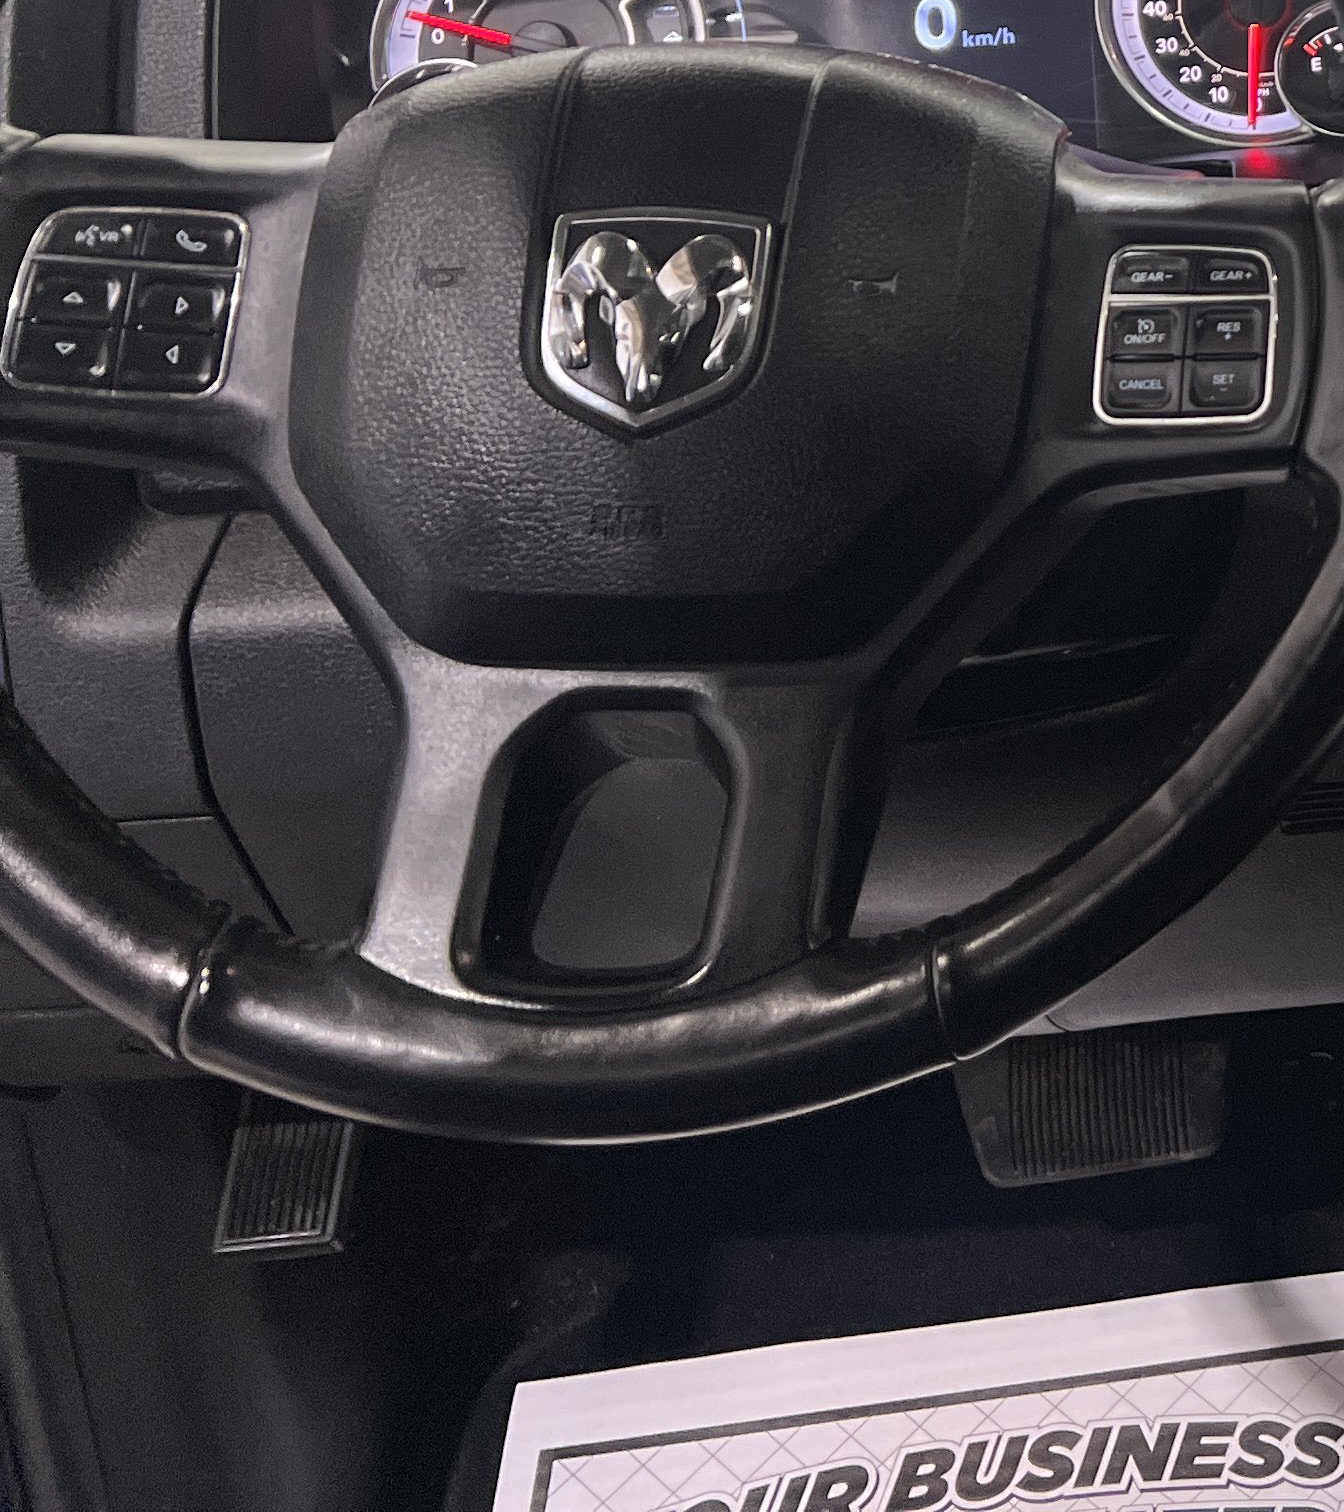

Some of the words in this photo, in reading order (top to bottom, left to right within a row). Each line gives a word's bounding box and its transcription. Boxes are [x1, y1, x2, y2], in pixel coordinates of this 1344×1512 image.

[1143, 0, 1167, 17] 40
[431, 27, 445, 45] 0
[961, 27, 1016, 48] km/h
[1155, 37, 1179, 54] 30
[1310, 57, 1322, 72] E
[1179, 65, 1201, 83] 20
[1208, 85, 1230, 103] 10
[1217, 322, 1241, 332] RES
[1124, 333, 1166, 345] ON/OFF
[1118, 379, 1164, 390] CANCEL
[1212, 374, 1234, 385] SET
